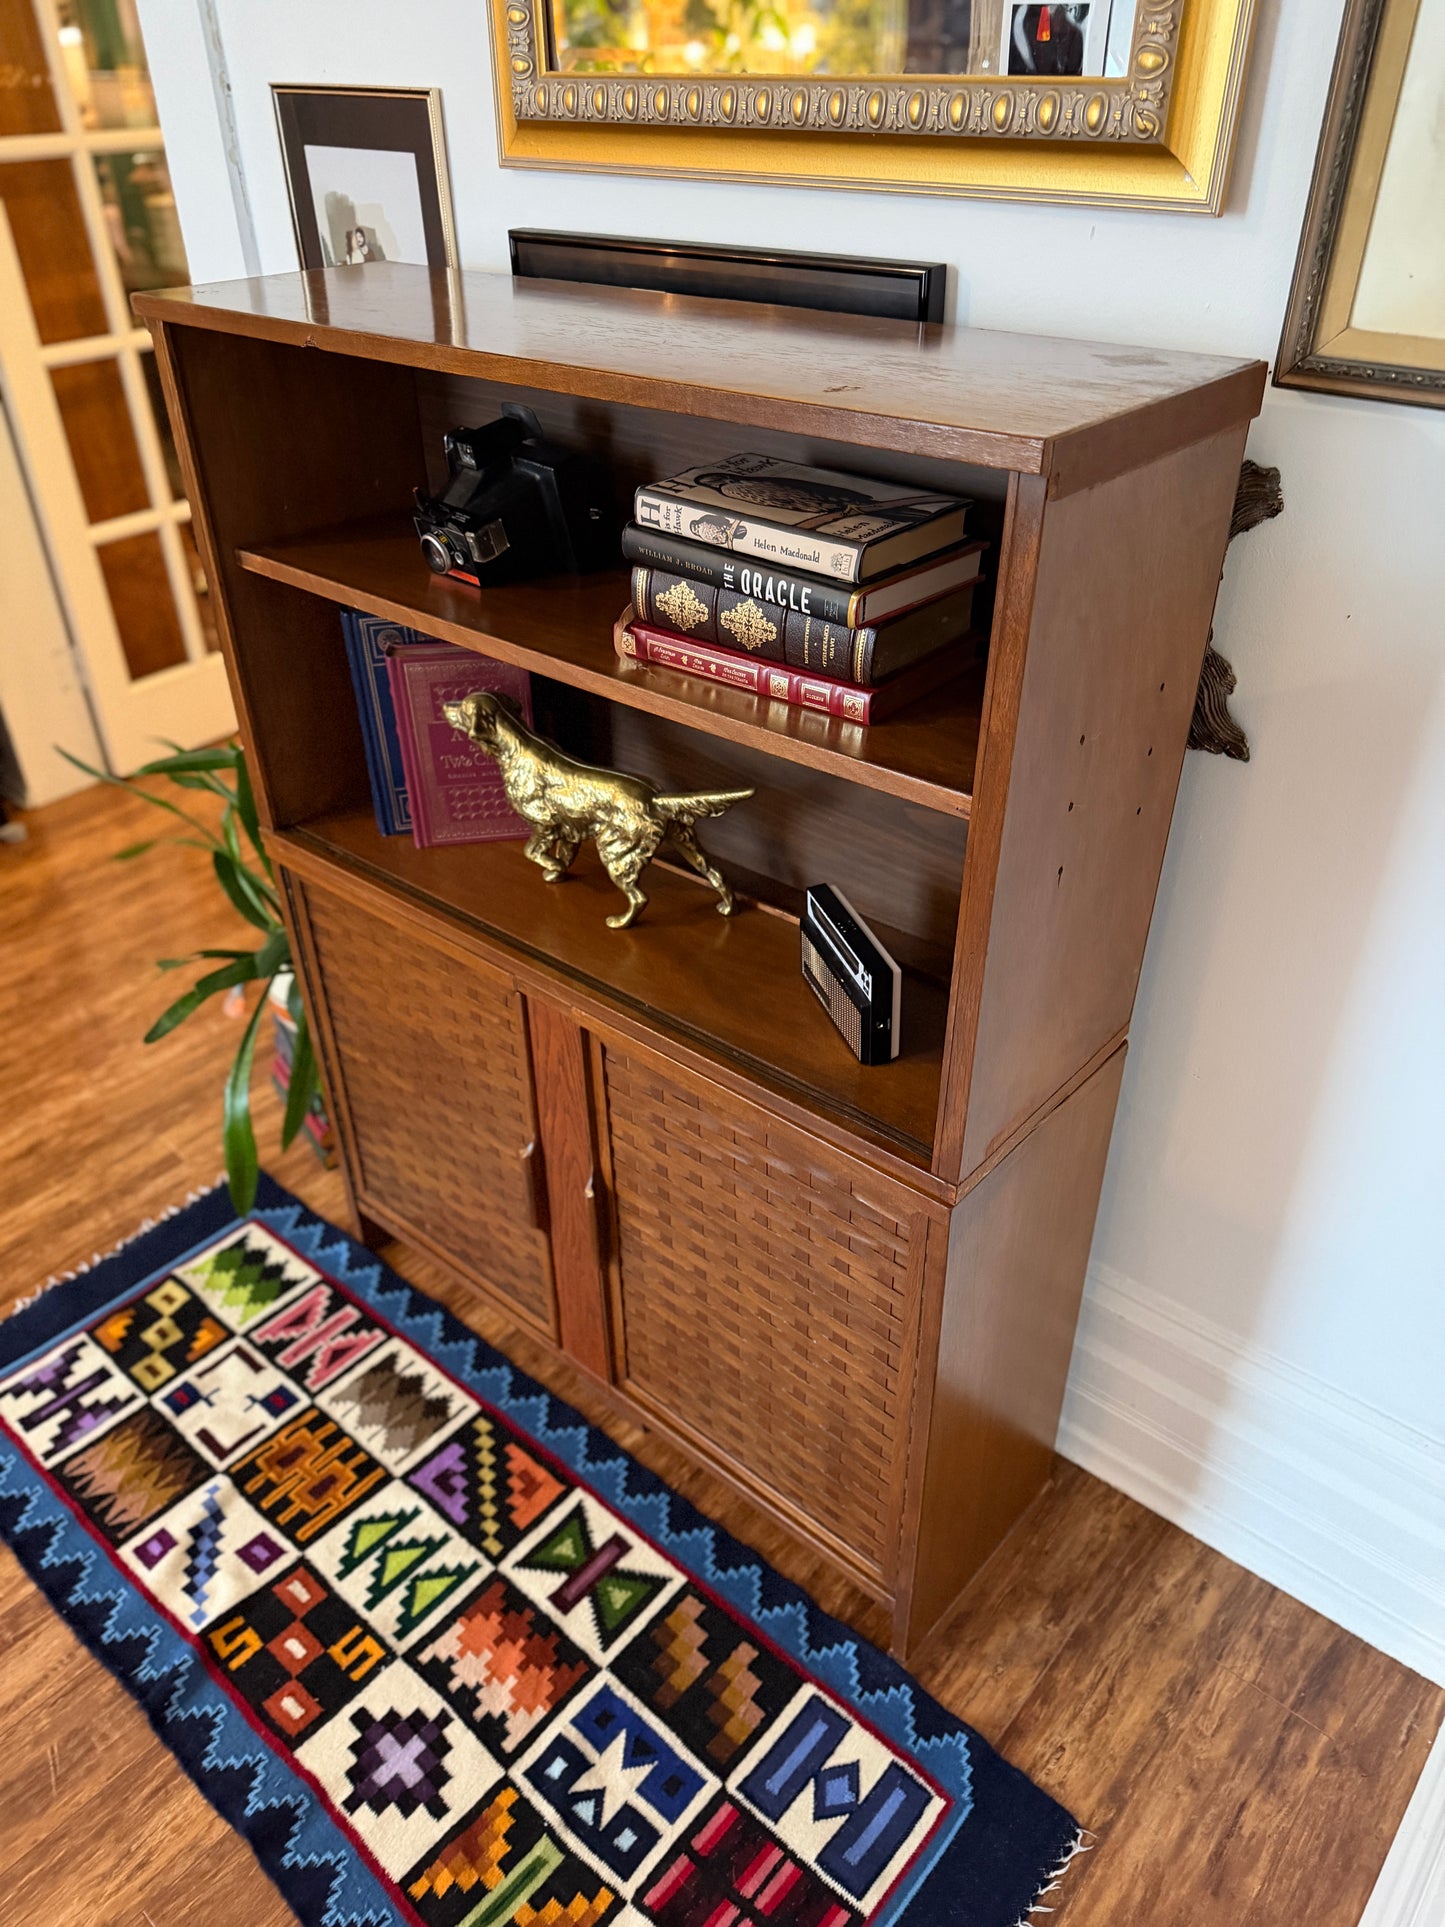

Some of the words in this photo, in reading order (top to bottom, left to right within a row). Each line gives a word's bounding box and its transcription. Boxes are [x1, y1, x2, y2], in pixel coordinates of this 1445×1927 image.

[653, 480, 698, 494] H
[641, 498, 661, 529] H
[663, 505, 671, 522] for
[665, 523, 672, 531] is
[672, 504, 683, 536] Hawk
[638, 546, 673, 565] WILLIAM
[675, 558, 684, 567] J.
[685, 561, 714, 576] BROAD
[753, 537, 777, 553] Helen
[779, 545, 821, 564] Macdonald
[723, 562, 736, 590] THE
[740, 568, 813, 616] ORACLE
